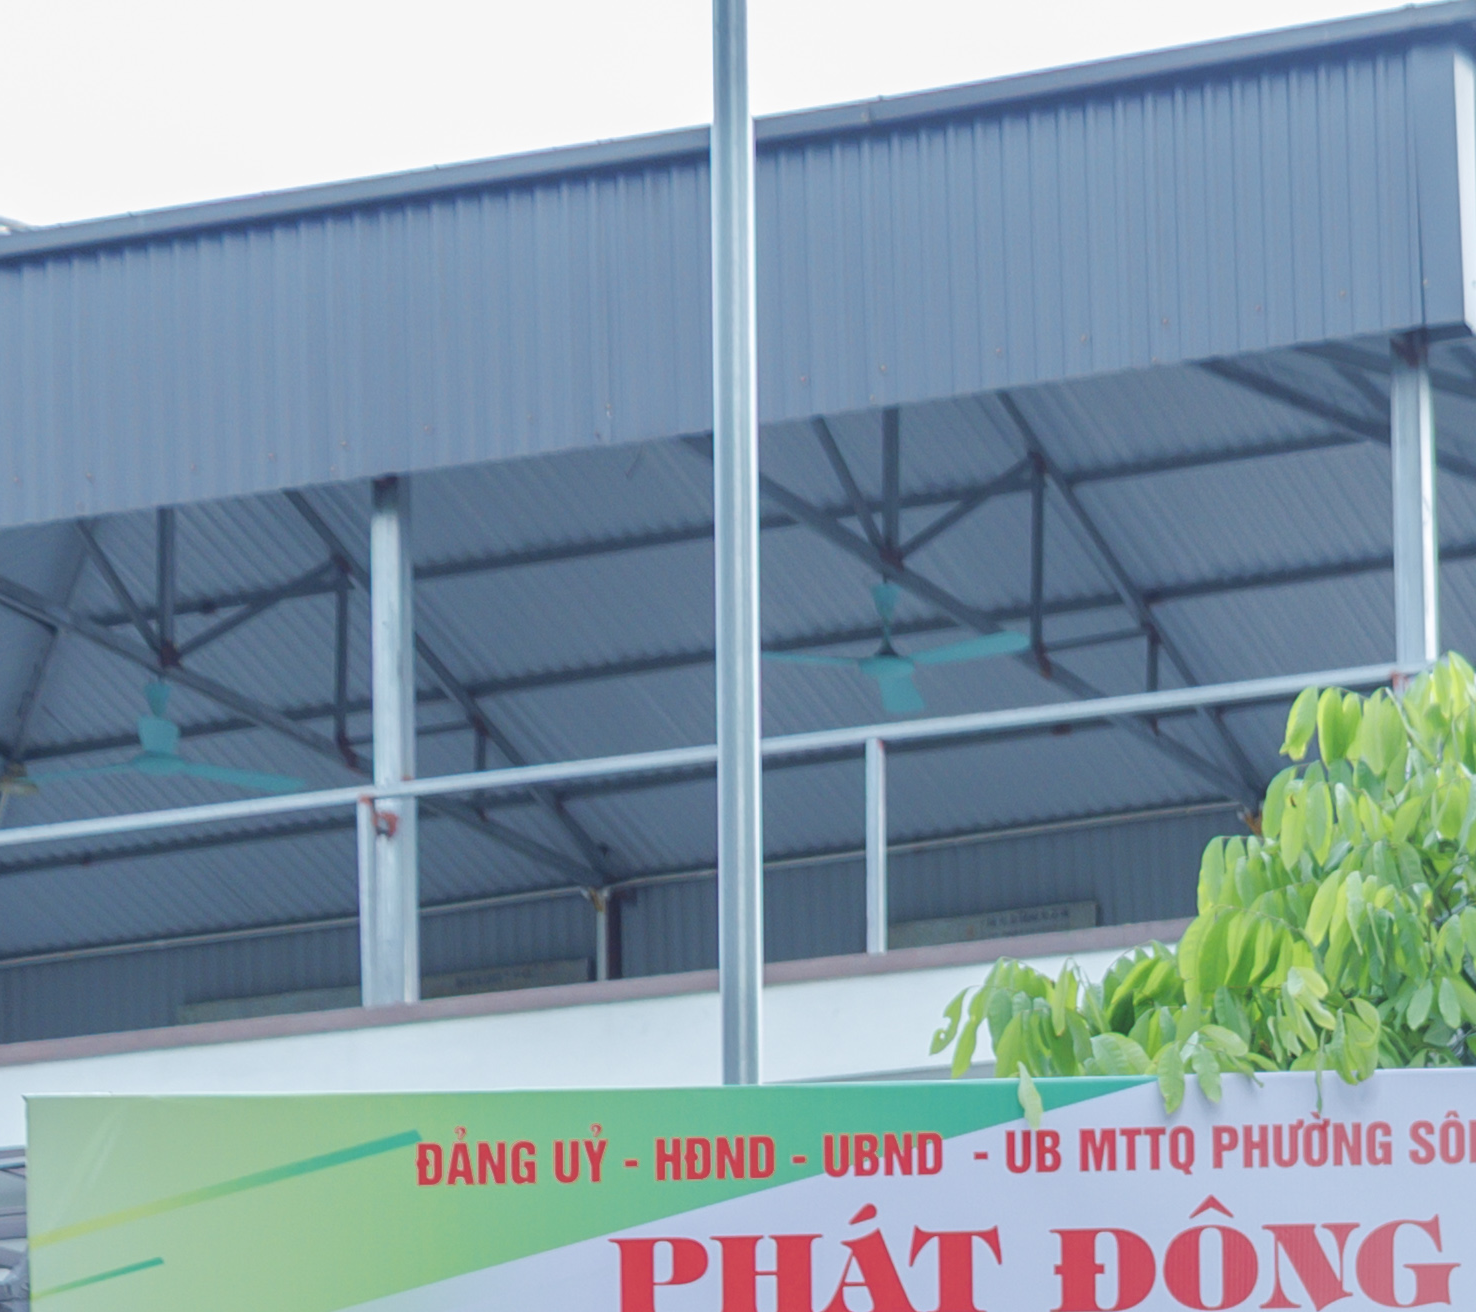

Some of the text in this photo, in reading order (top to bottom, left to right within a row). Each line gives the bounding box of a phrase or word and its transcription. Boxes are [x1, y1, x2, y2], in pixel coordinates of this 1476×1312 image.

[416, 1126, 536, 1185] ĐẢNG
[553, 1123, 607, 1183] UỶ
[656, 1136, 776, 1181] HĐND
[824, 1132, 943, 1177] UBND
[1004, 1130, 1062, 1174] UB
[1079, 1127, 1195, 1175] MTTQ
[1211, 1112, 1393, 1169] PHƯỜNG
